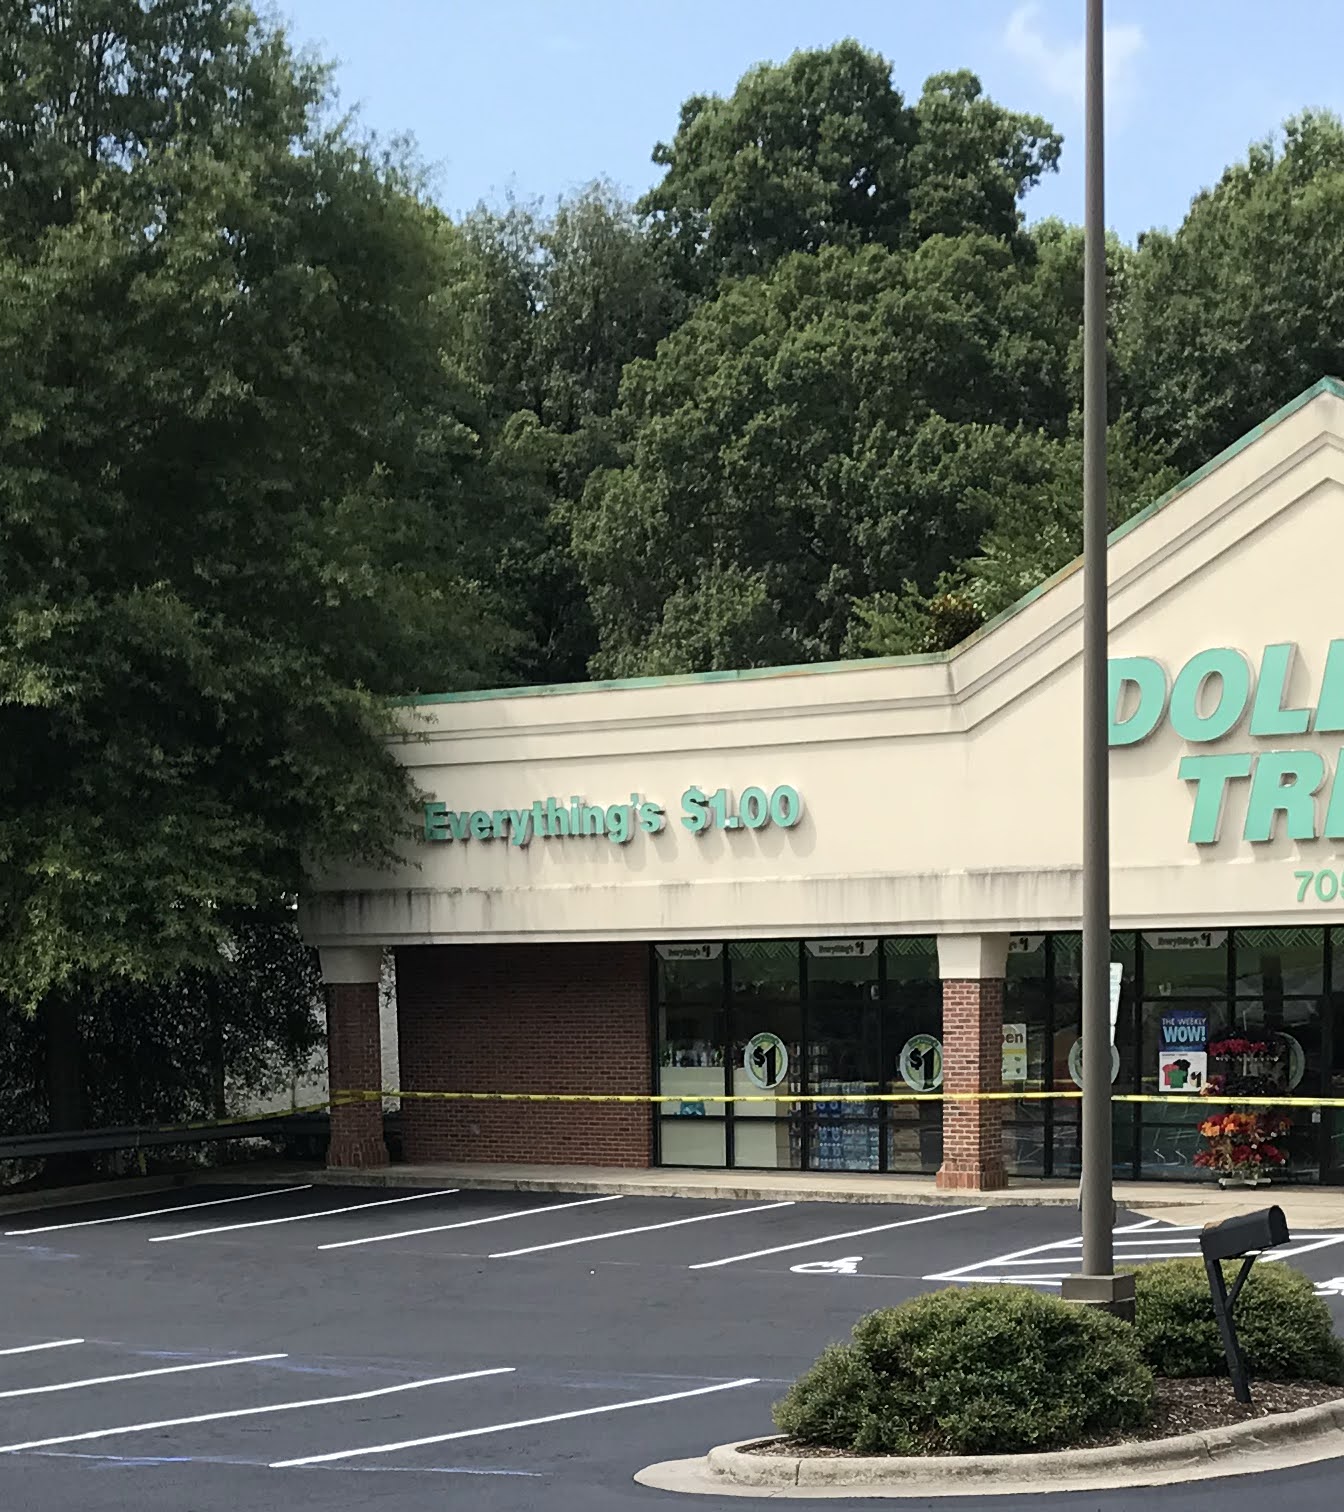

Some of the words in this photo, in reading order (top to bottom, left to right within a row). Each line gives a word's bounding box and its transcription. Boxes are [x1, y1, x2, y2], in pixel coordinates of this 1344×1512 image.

[423, 792, 665, 847] Everything's
[681, 784, 806, 833] $1.00
[1005, 1032, 1024, 1044] en
[1162, 1025, 1206, 1043] WOW!
[752, 1045, 777, 1086] $1
[909, 1046, 935, 1090] $1
